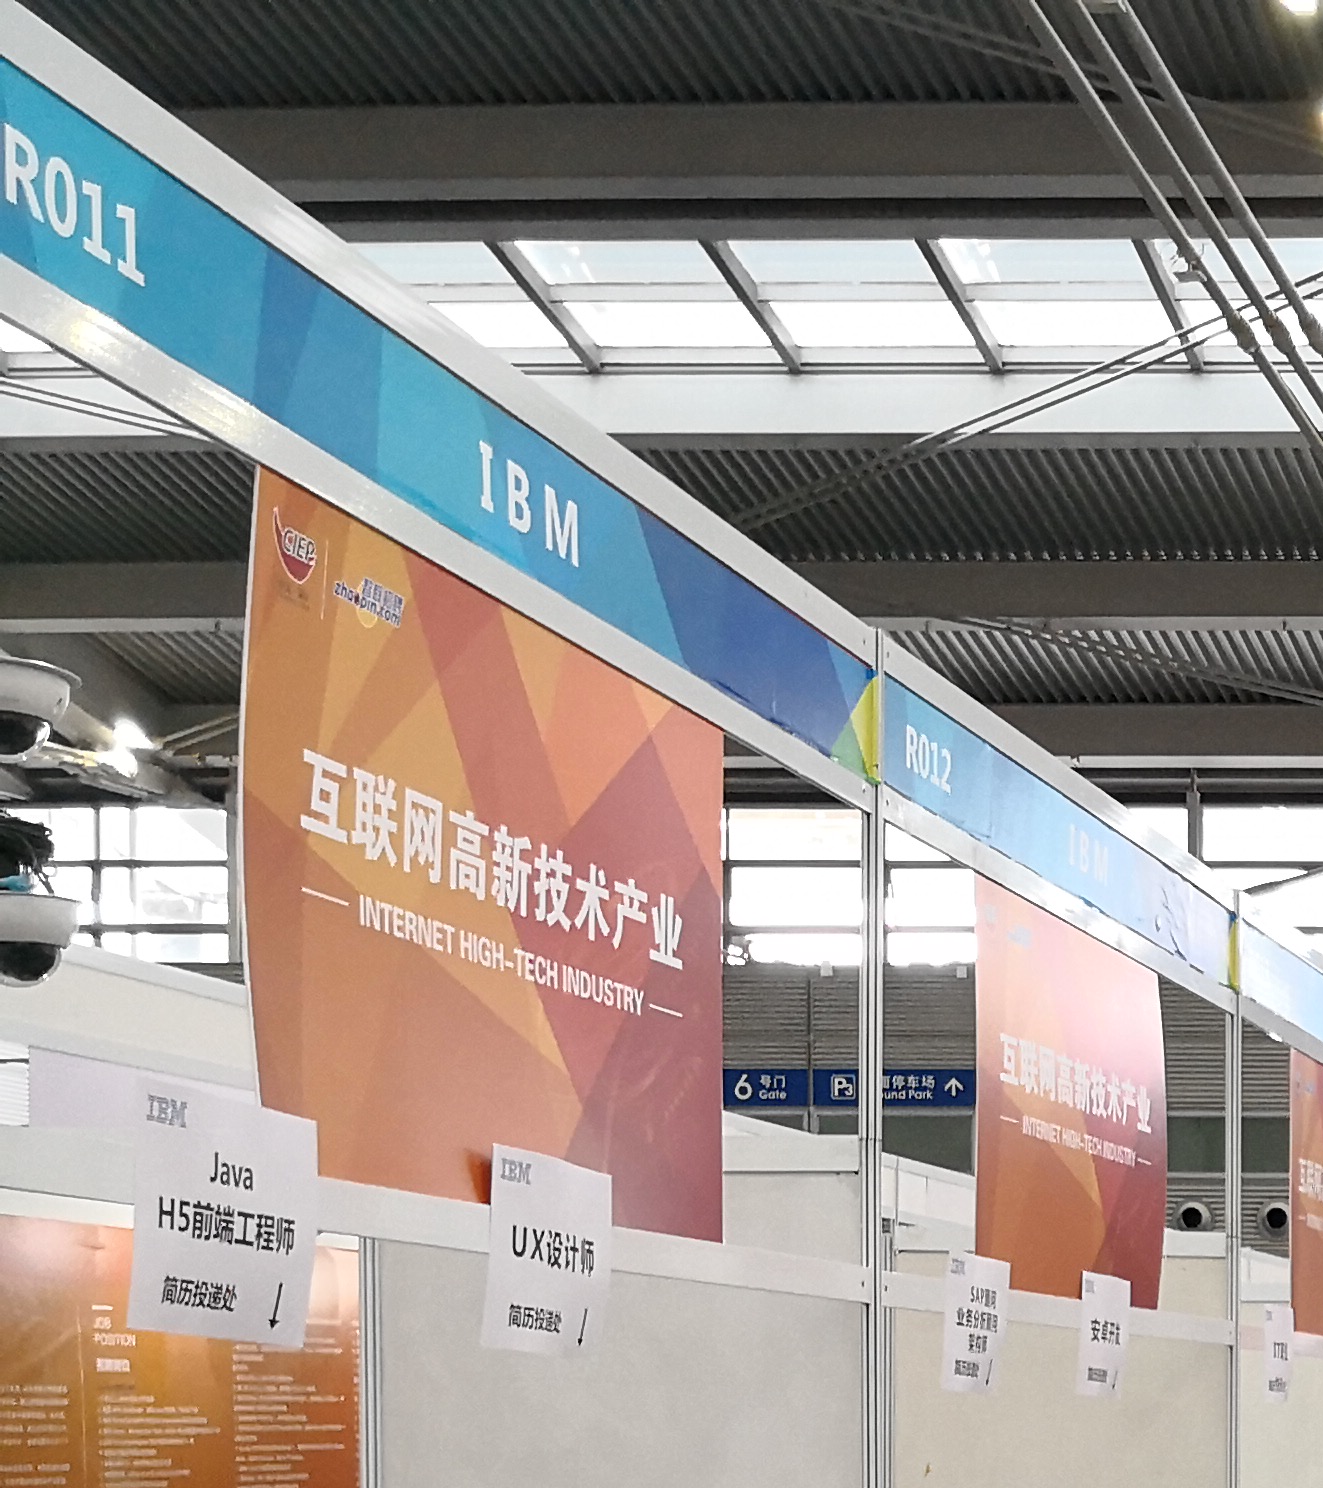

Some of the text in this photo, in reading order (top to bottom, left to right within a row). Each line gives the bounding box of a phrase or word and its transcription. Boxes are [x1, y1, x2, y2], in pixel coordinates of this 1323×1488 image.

[4, 122, 147, 288] R011
[478, 440, 582, 569] IBM
[905, 724, 952, 796] R012
[300, 748, 684, 970] 互联网高新技术产业
[1068, 822, 1109, 888] IBM
[358, 894, 646, 1016] INTERNET HIGH-TECH INDUSTRY
[734, 1073, 753, 1101] 6
[758, 1074, 788, 1089] 号门
[758, 1089, 788, 1101] Gate
[908, 1090, 933, 1100] Park
[999, 1032, 1153, 1134] 互联网高新技术产业
[146, 1093, 188, 1129] IBM
[1021, 1114, 1062, 1144] INTERNET
[210, 1151, 254, 1191] Java
[500, 1158, 532, 1185] IBM
[157, 1196, 296, 1256] H5前端工程师
[512, 1225, 595, 1278] UX设计师
[161, 1275, 238, 1313] 简历投递处
[508, 1303, 562, 1334] 简历投递处
[1090, 1317, 1121, 1346] 安卓开发
